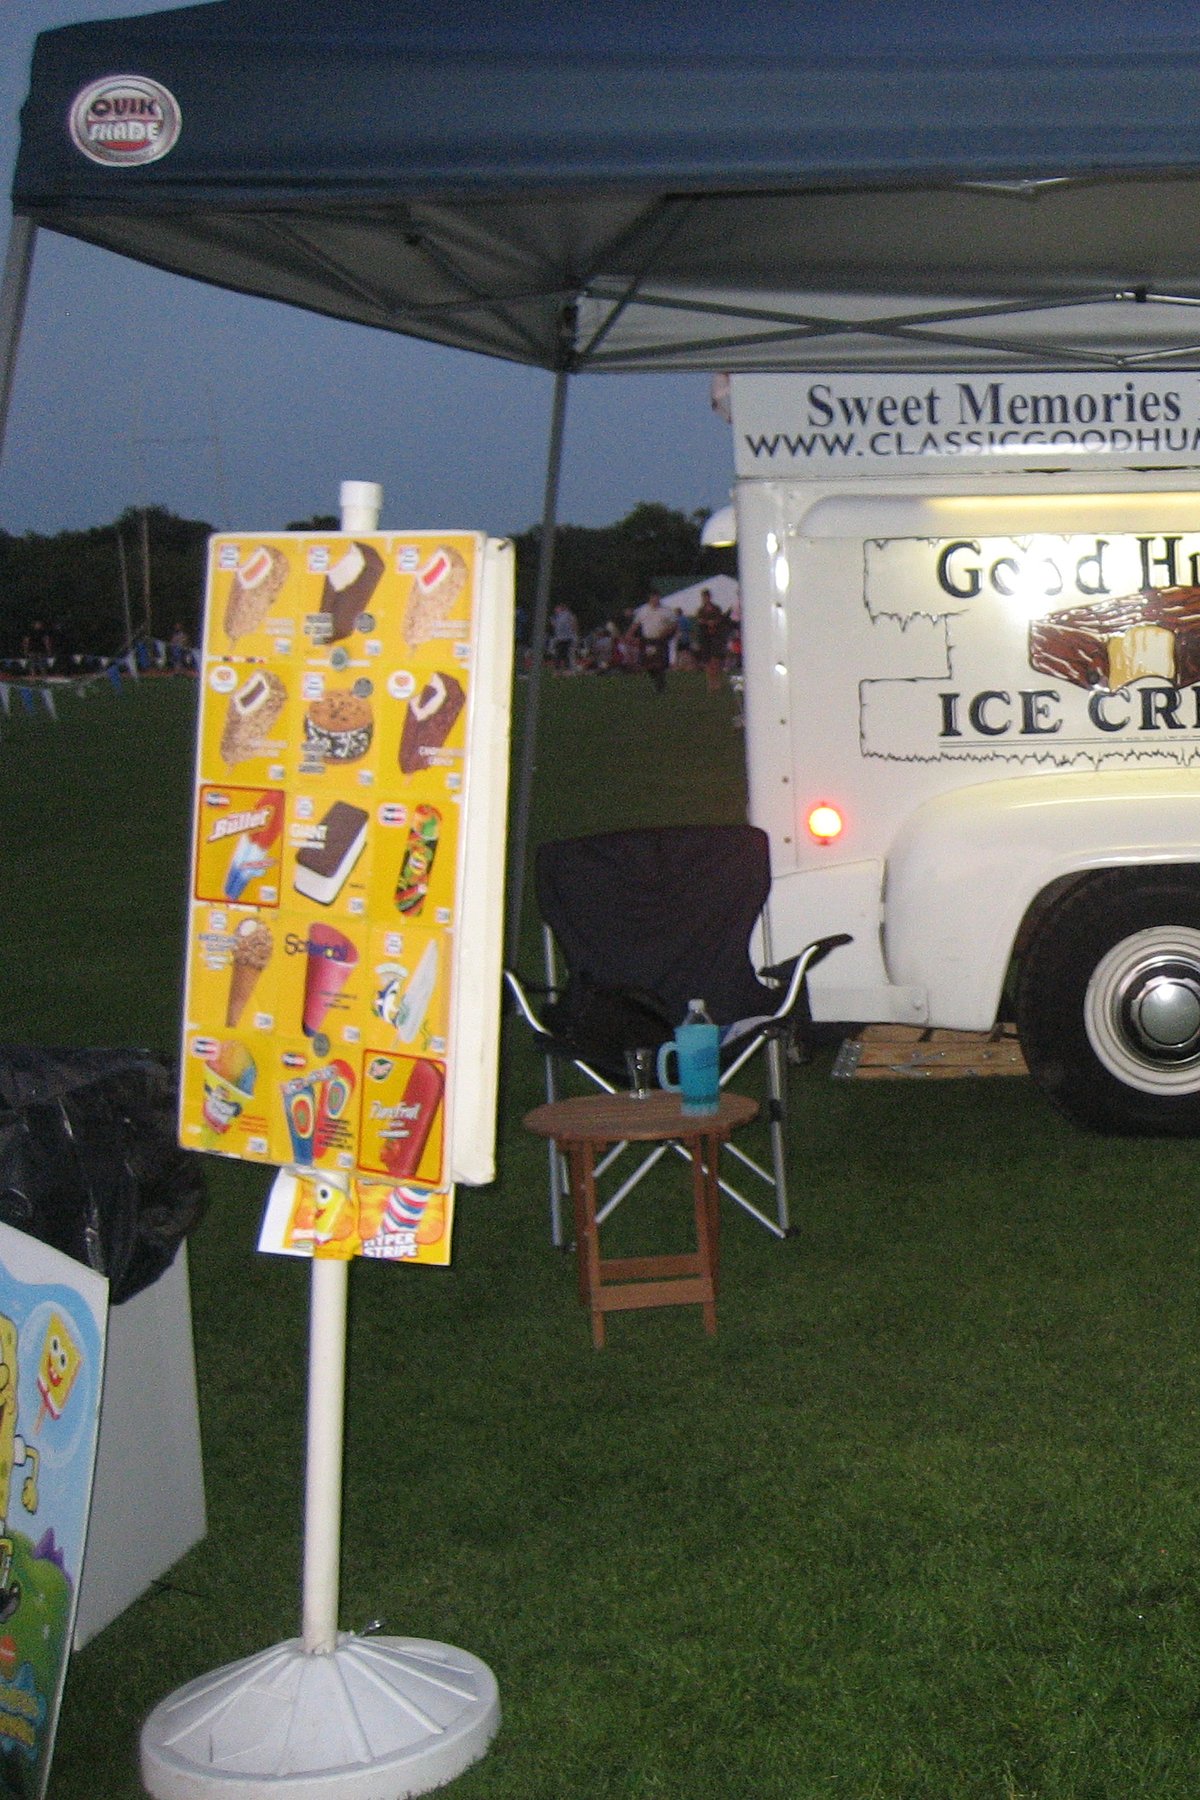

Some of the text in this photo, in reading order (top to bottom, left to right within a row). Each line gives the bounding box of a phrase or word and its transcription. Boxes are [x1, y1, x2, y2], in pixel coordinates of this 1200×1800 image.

[91, 98, 157, 116] QUIK
[807, 383, 942, 428] Sweet
[957, 381, 1181, 425] Memories
[937, 539, 1110, 599] Good
[938, 689, 1064, 737] ICE
